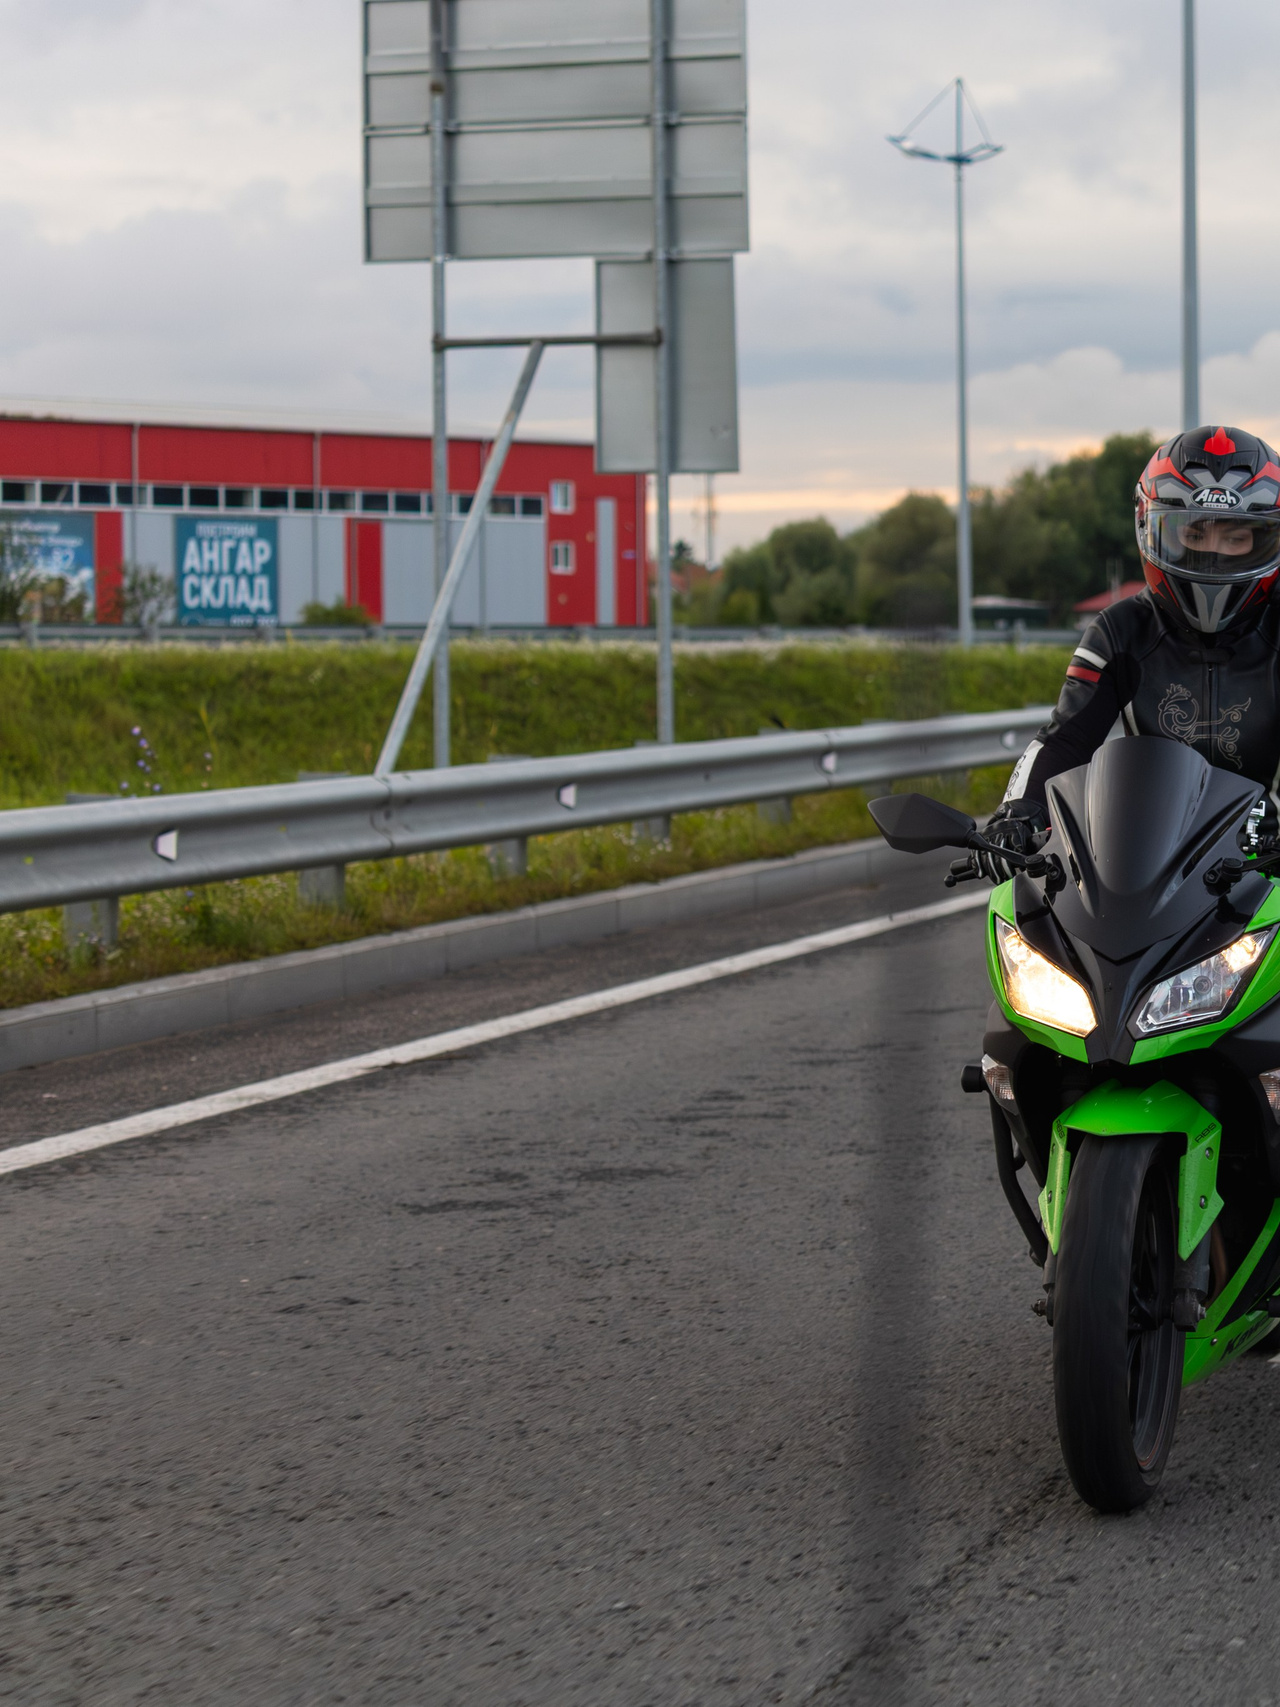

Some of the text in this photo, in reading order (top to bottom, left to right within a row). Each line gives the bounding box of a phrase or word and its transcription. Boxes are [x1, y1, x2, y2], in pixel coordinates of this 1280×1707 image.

[1194, 488, 1237, 504] Airoh
[183, 538, 272, 574] АНГАР
[183, 575, 271, 613] СКЛАД
[1195, 1122, 1216, 1143] ABS
